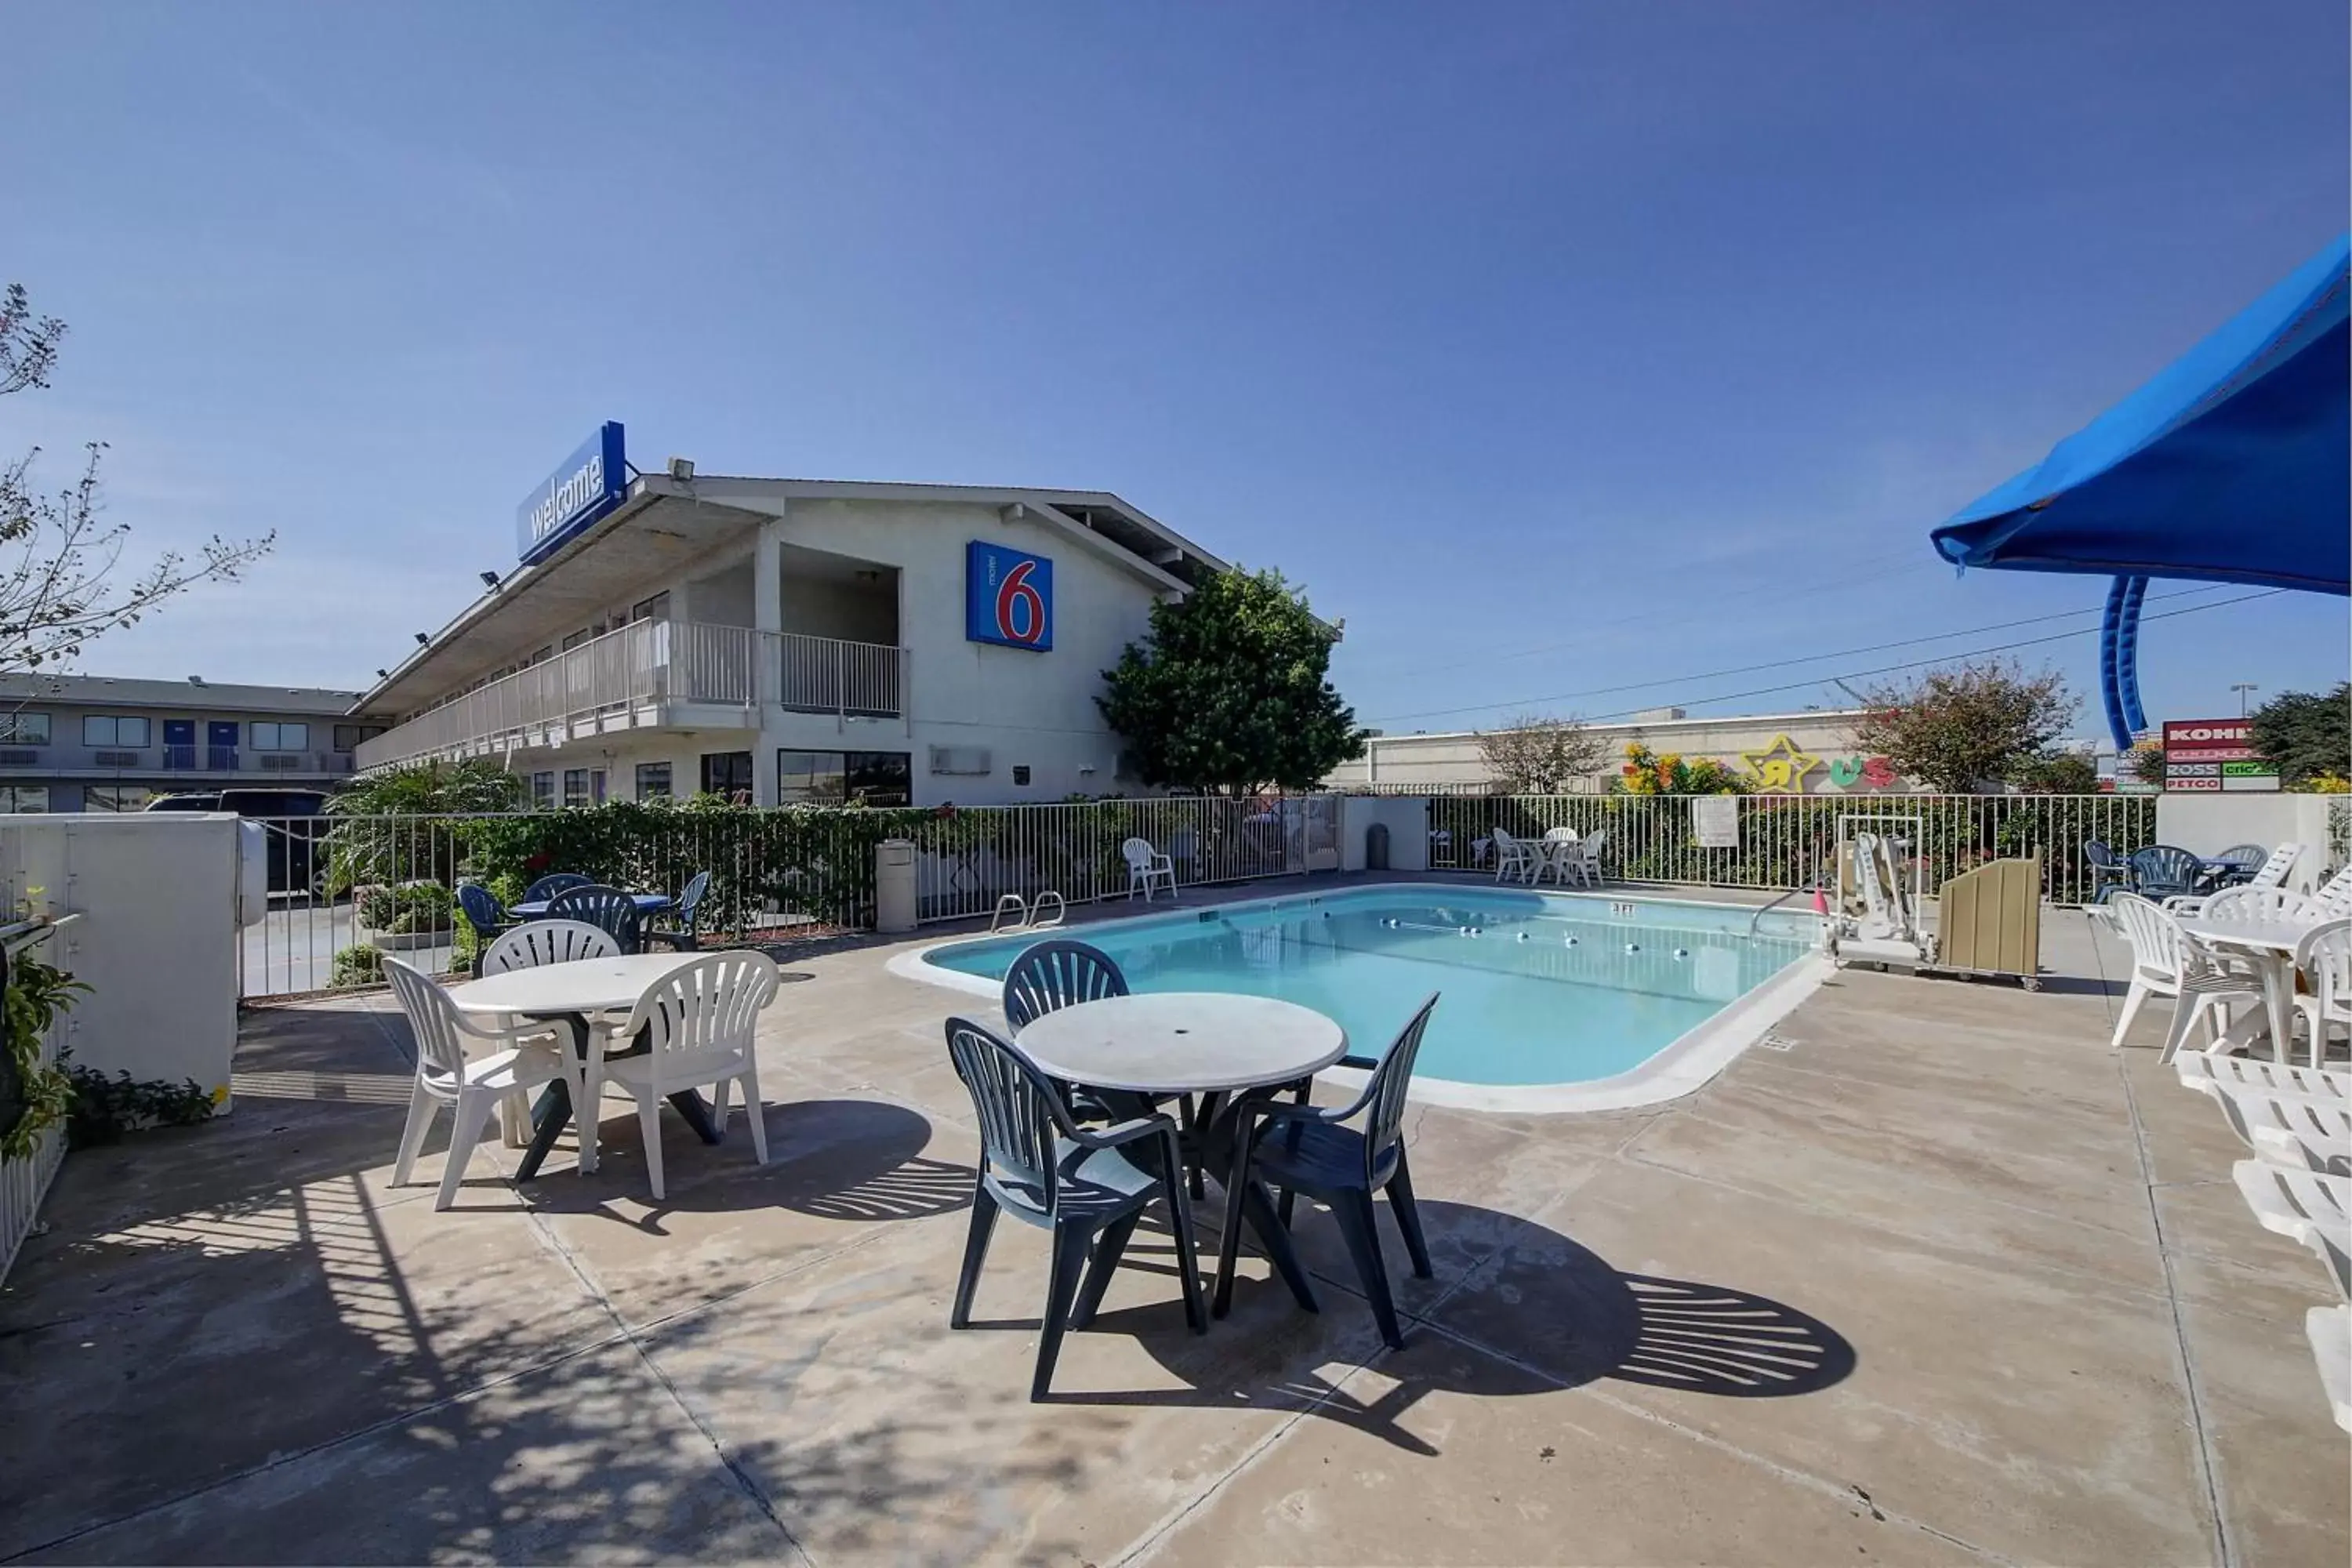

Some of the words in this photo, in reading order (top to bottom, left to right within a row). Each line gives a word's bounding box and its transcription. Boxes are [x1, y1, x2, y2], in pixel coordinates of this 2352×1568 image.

[531, 455, 604, 542] welcome
[996, 561, 1045, 645] 6
[2166, 764, 2218, 776] ROSS
[2168, 779, 2219, 788] PETCO
